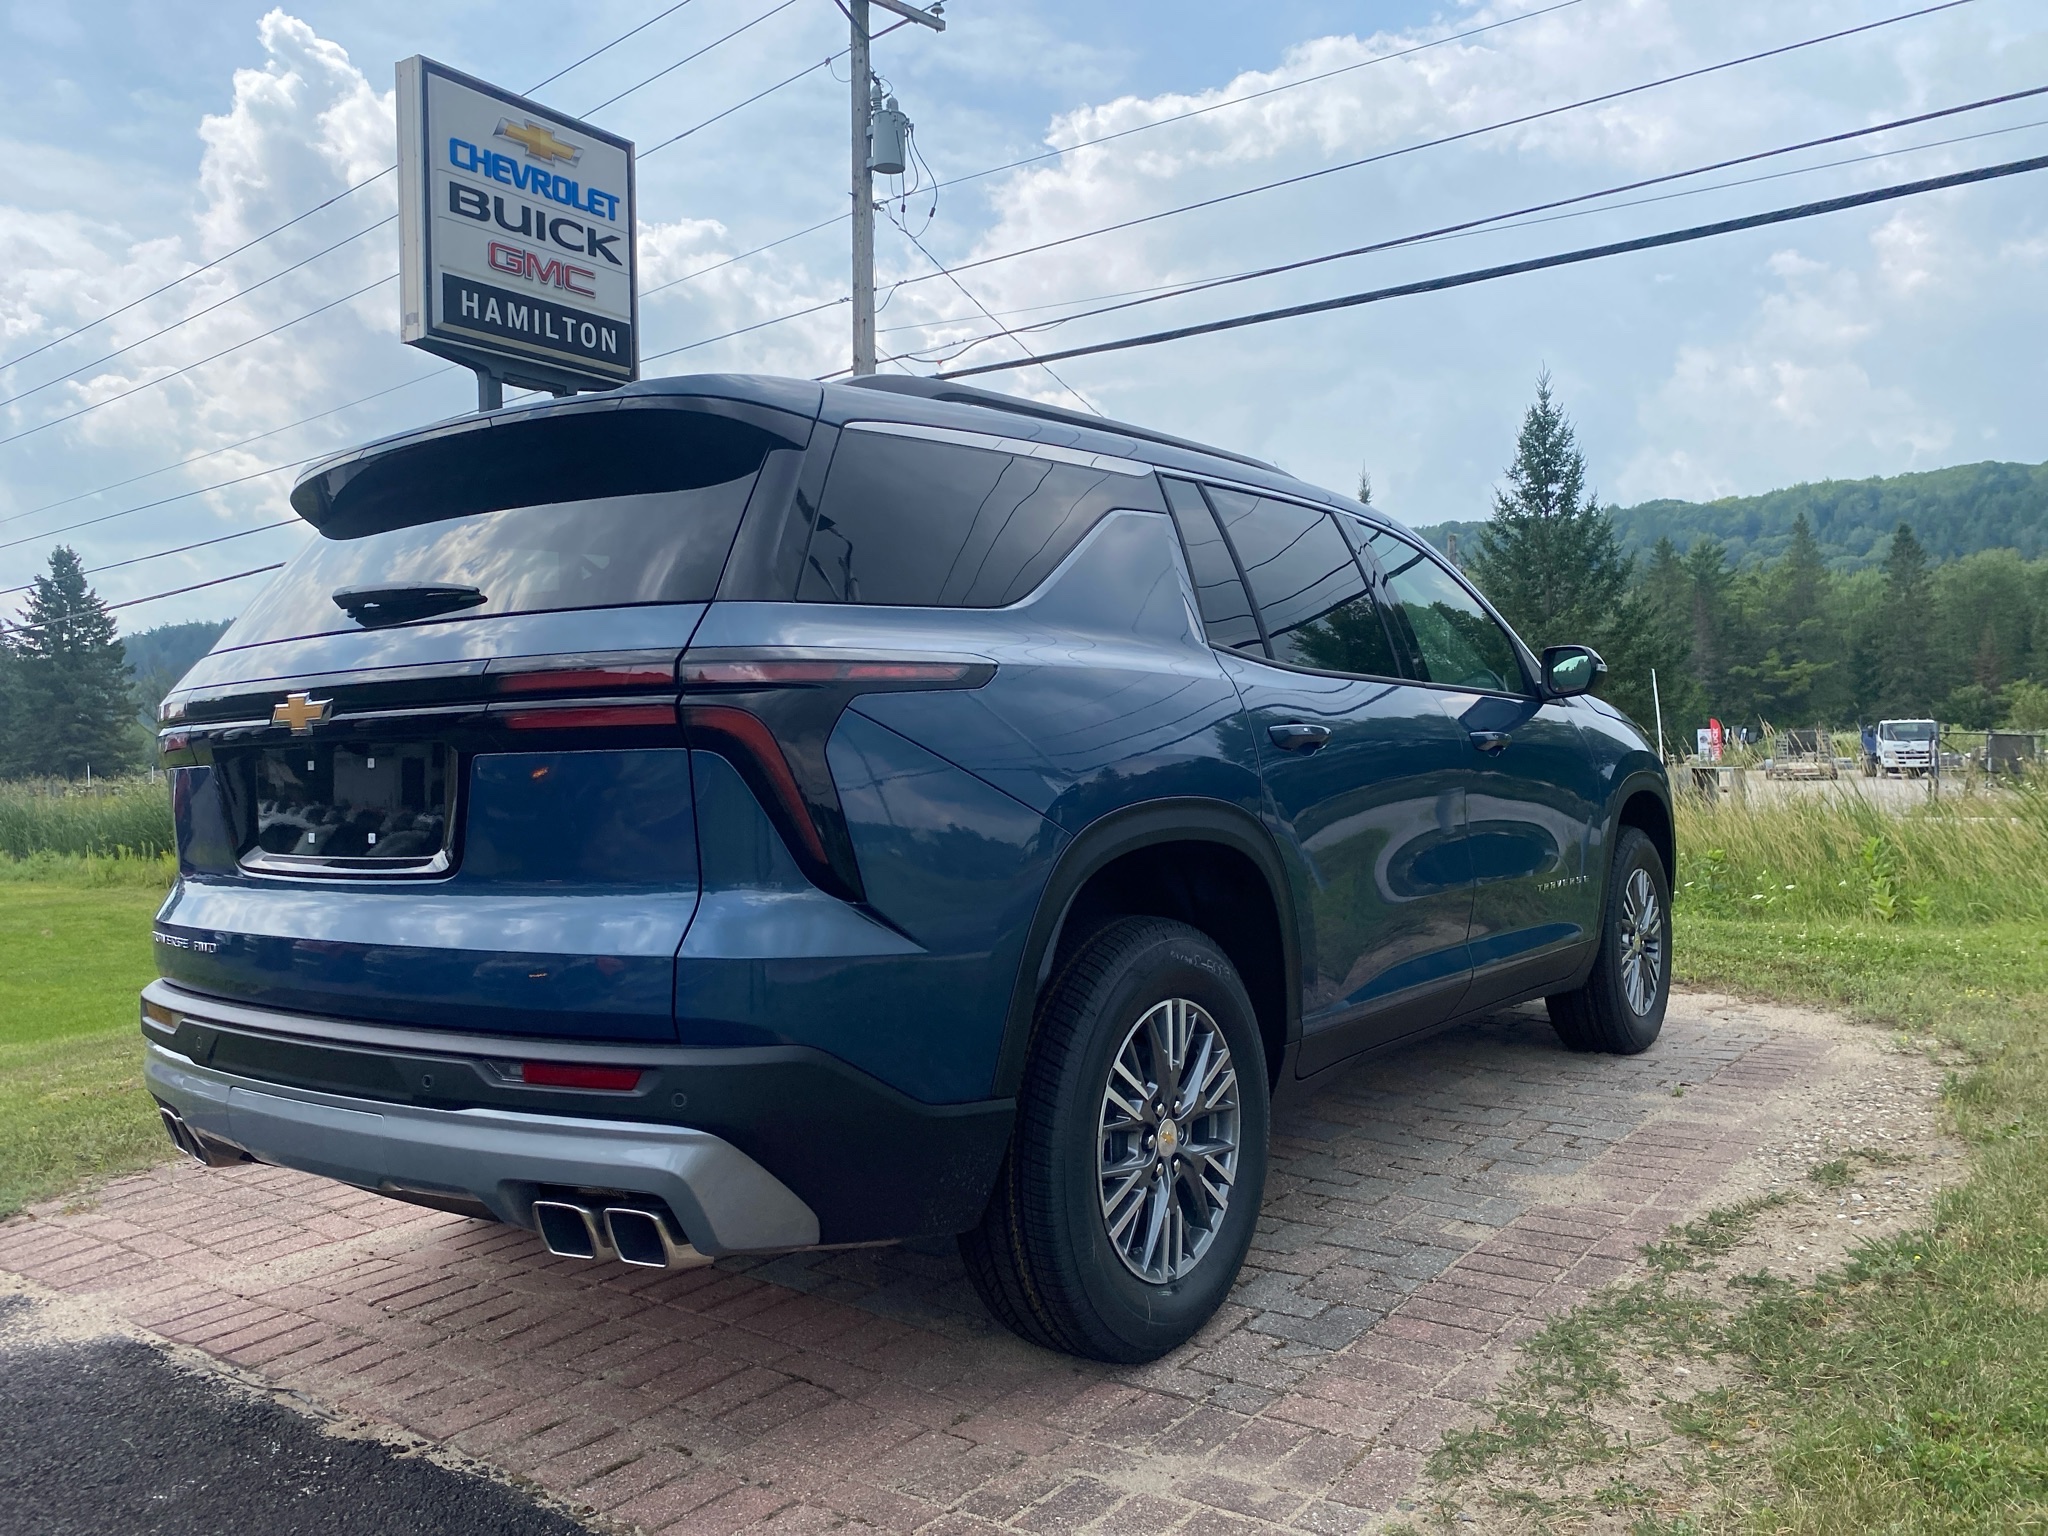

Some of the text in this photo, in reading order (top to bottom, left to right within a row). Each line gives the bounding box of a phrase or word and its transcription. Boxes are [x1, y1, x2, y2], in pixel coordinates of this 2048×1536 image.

[449, 137, 620, 221] CHEVROLET
[449, 181, 623, 266] BUICK
[487, 239, 596, 299] GMC
[461, 289, 617, 354] HAMILTON
[1537, 875, 1590, 892] TRAVERSE
